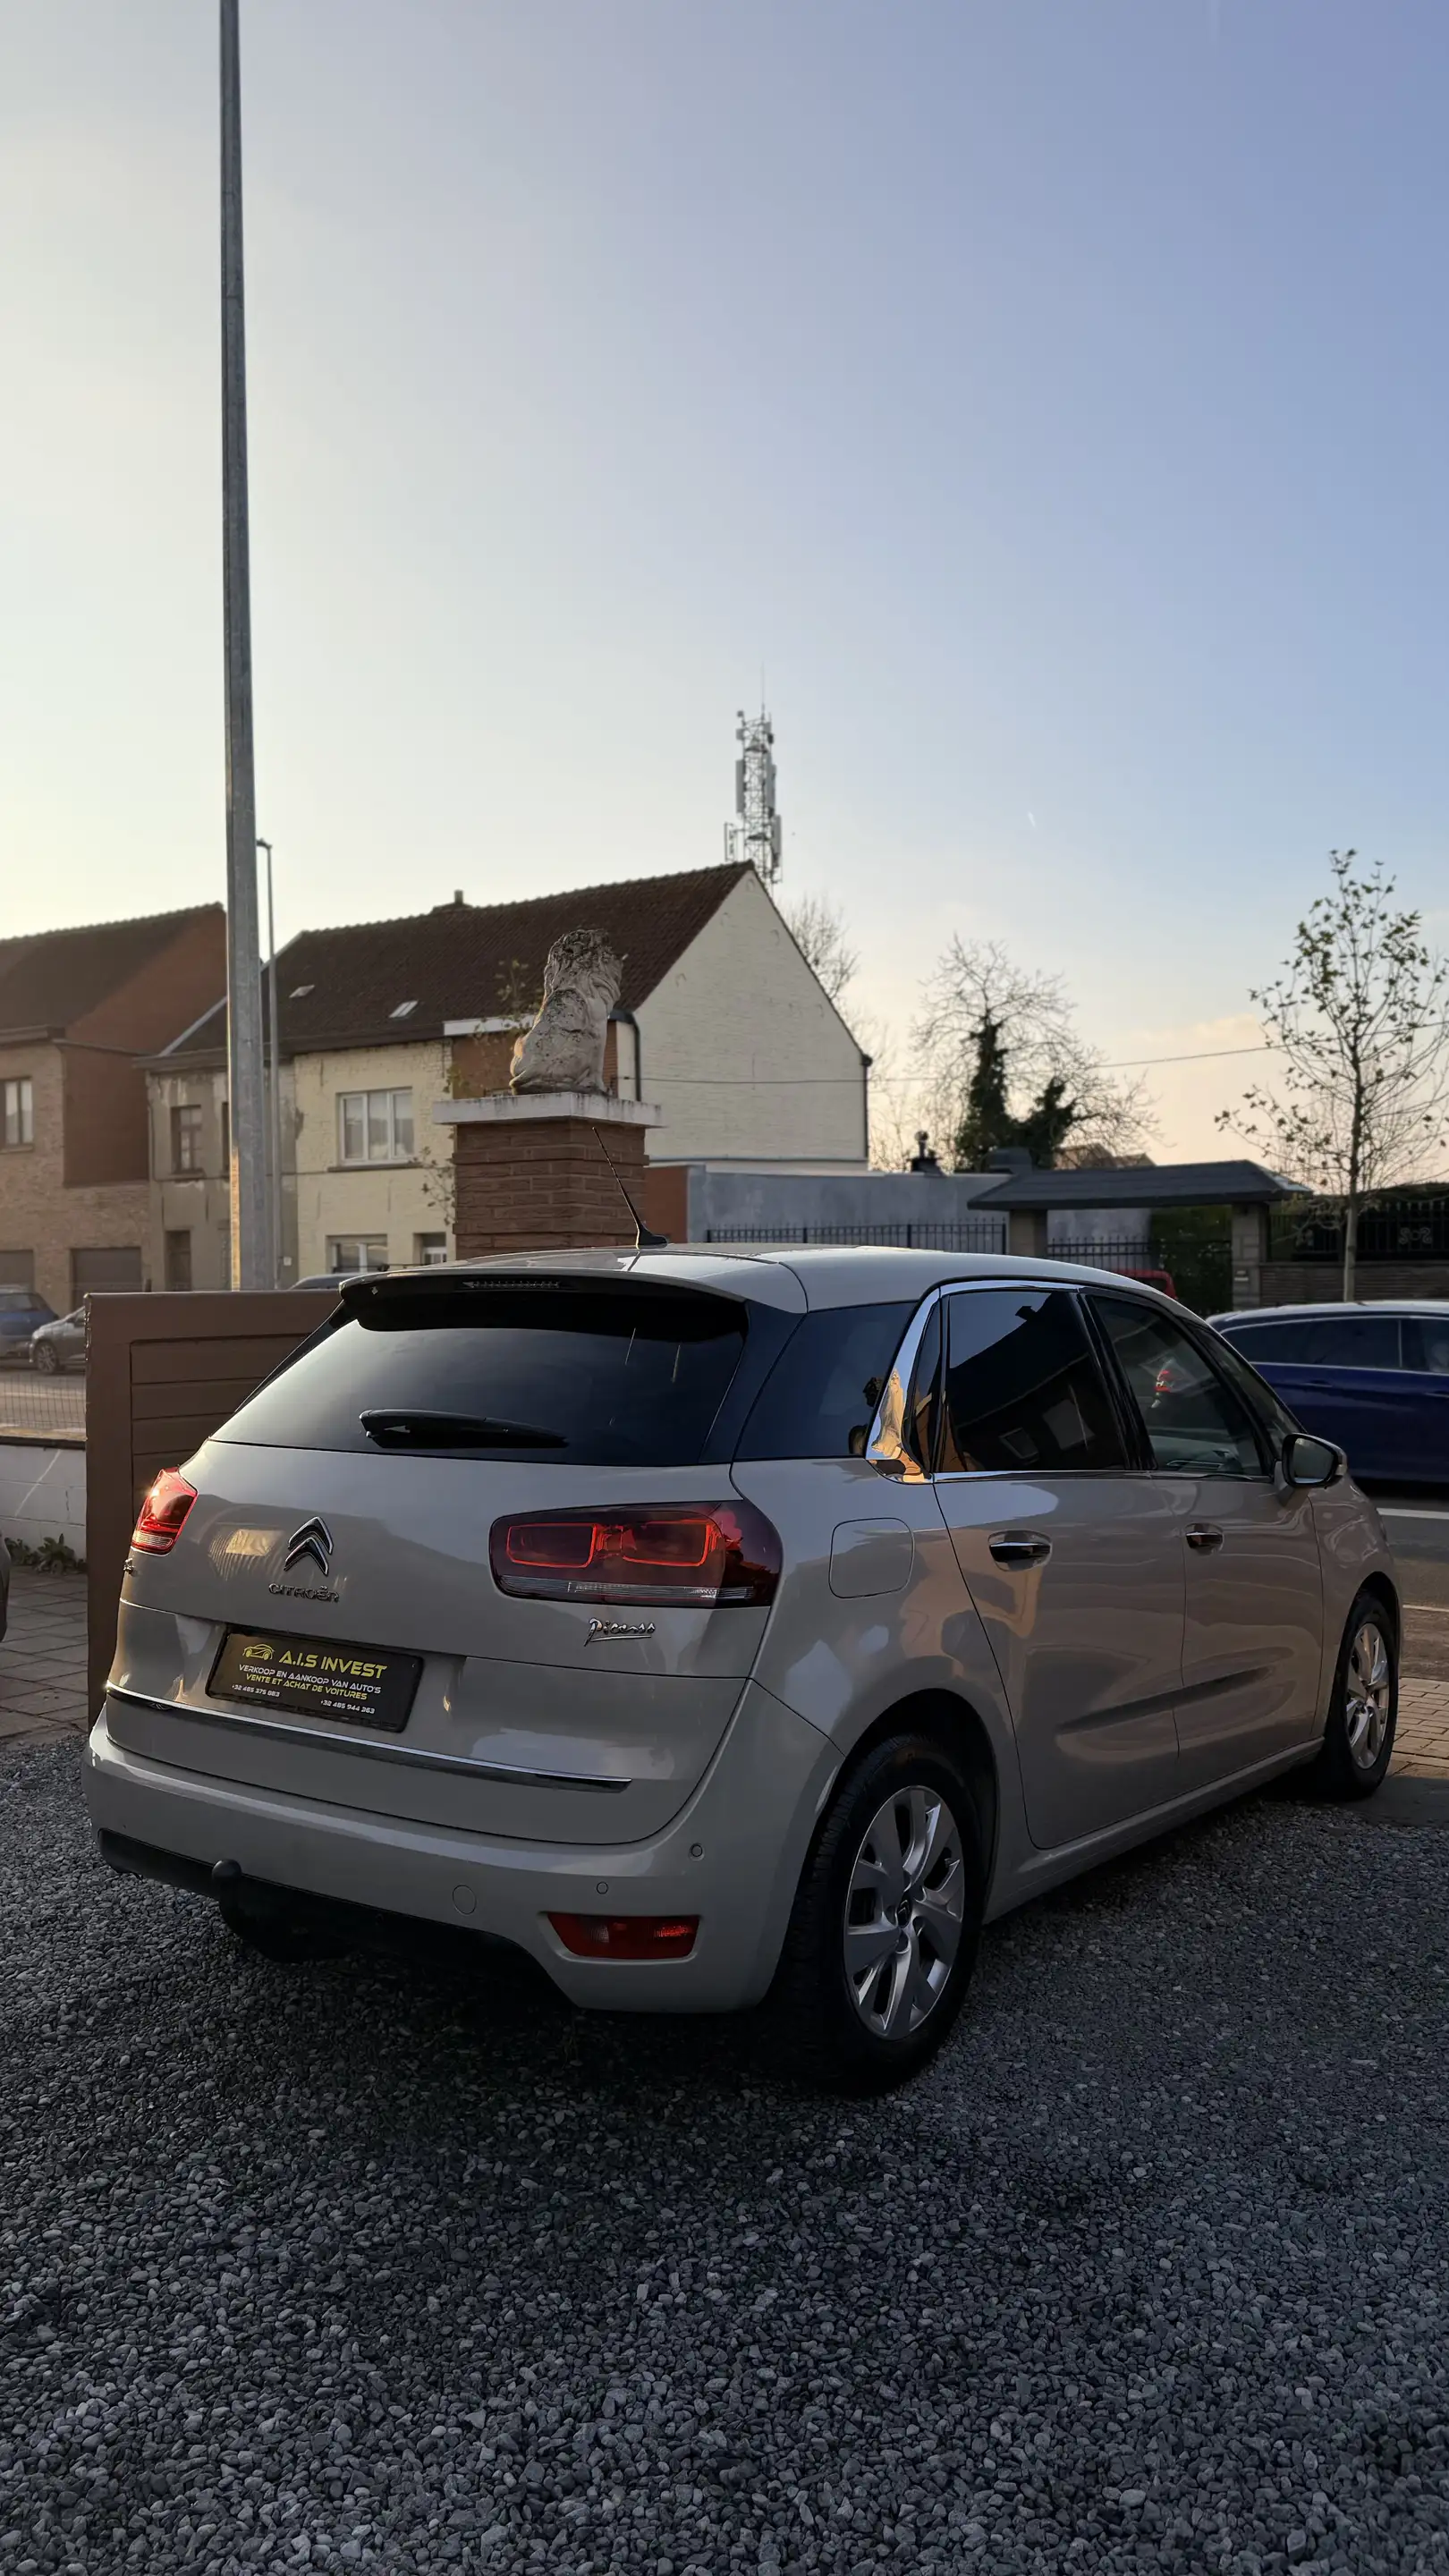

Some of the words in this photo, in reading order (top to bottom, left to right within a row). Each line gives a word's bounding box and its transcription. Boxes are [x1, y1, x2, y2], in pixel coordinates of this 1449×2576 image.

[583, 1617, 656, 1647] Picasso
[239, 1664, 275, 1675] VERKOOP
[276, 1670, 288, 1678] EN
[288, 1673, 330, 1685] AANKOOP
[331, 1679, 349, 1689] VAN
[350, 1682, 382, 1694] AUTO'S
[279, 1650, 318, 1668] A.I.S
[320, 1656, 387, 1679] INVEST
[246, 1673, 271, 1683] VENTE
[272, 1677, 283, 1685] ET
[284, 1680, 310, 1691] ACHAT
[311, 1684, 323, 1692] DE
[325, 1687, 368, 1700] VOITURES
